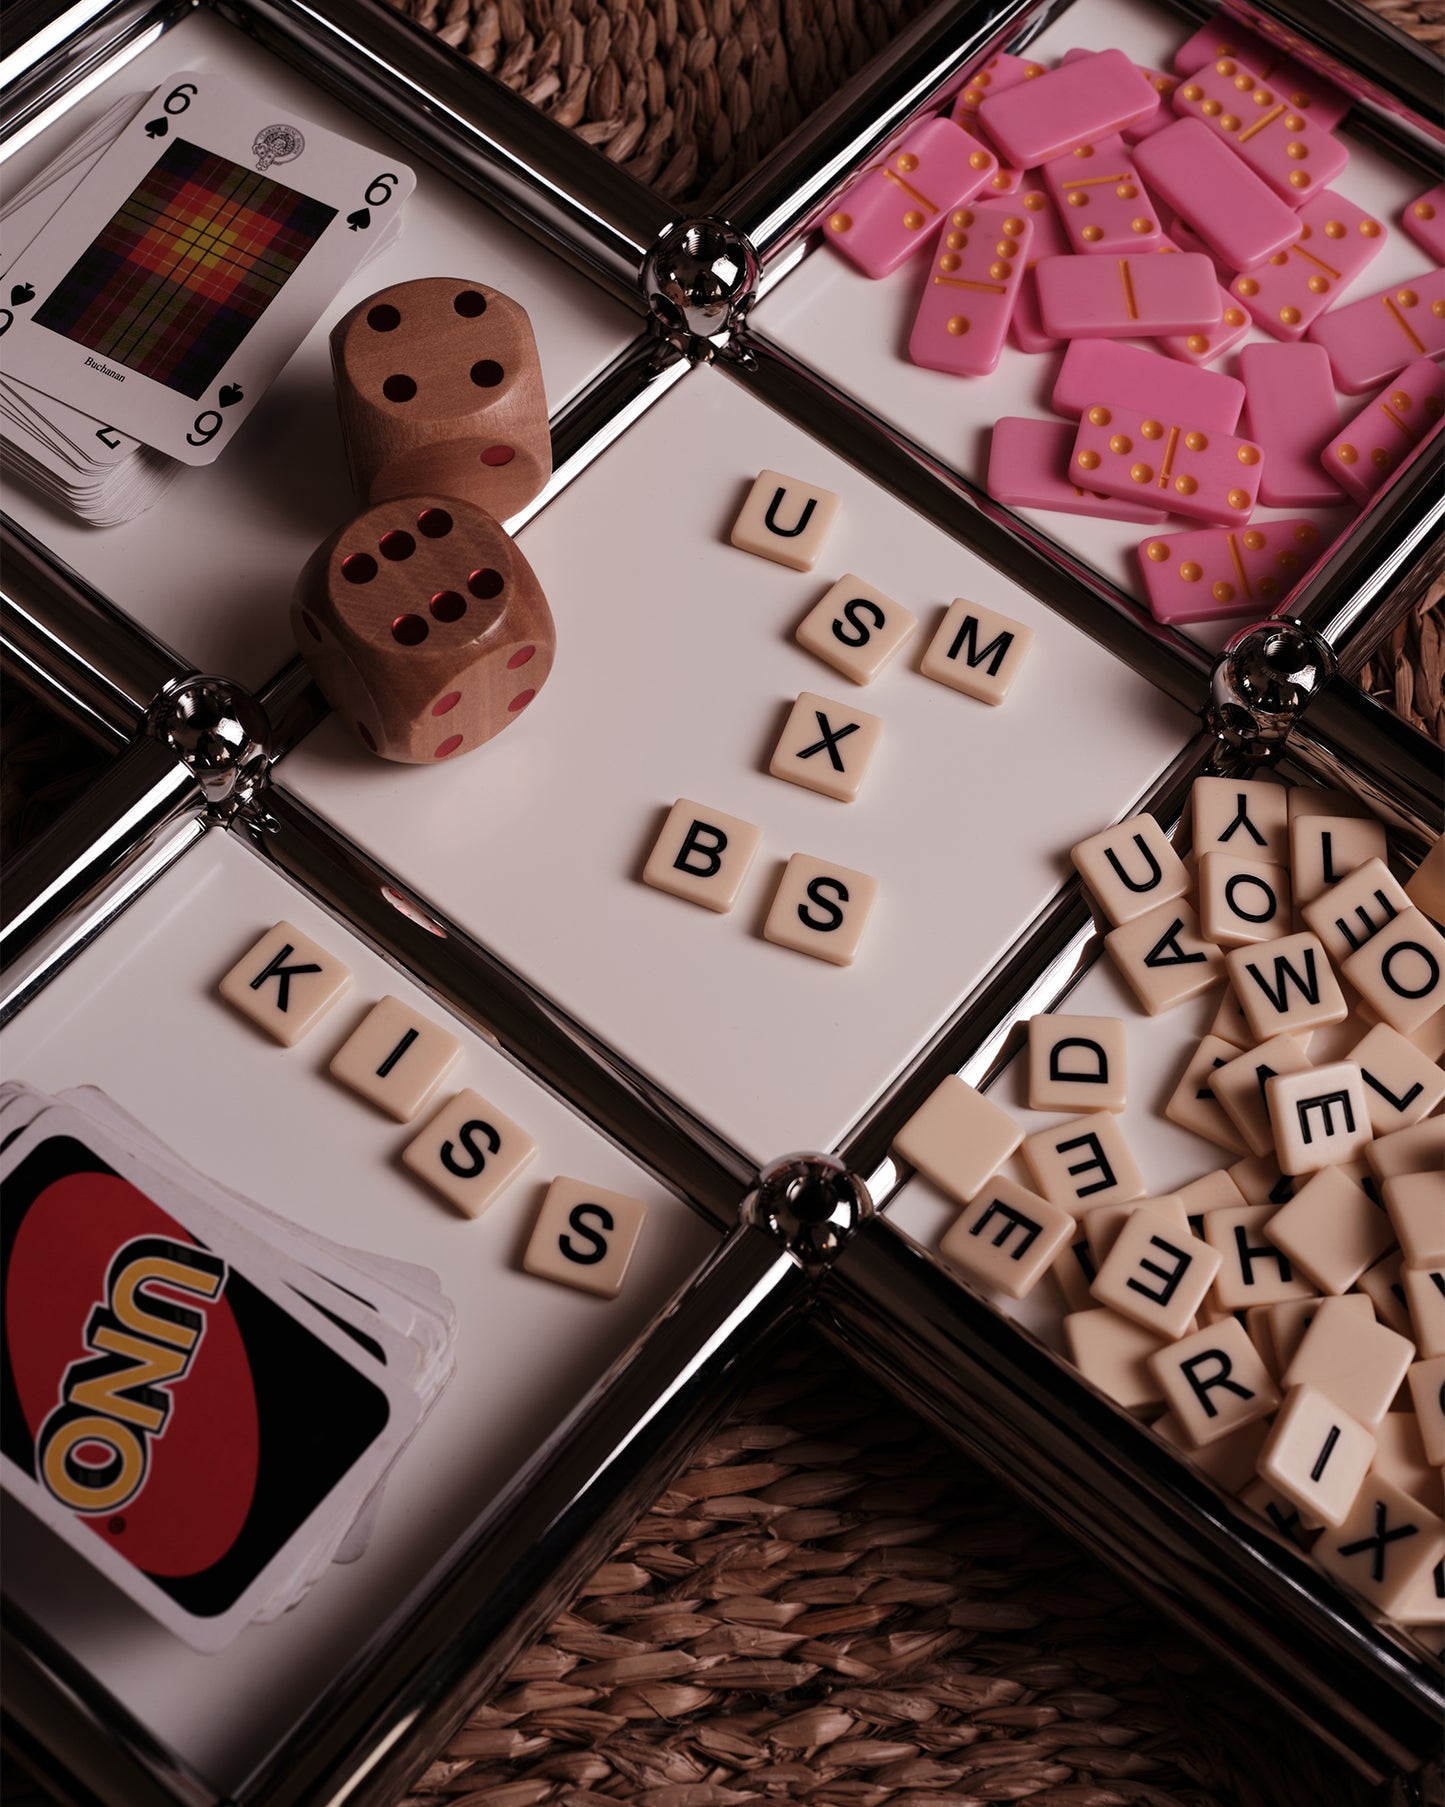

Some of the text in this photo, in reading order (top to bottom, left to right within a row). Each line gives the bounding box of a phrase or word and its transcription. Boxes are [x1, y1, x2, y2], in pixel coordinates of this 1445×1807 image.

[164, 84, 198, 115] 6
[364, 173, 399, 206] 6
[84, 356, 126, 383] Buchanan
[186, 410, 224, 447] 6
[764, 487, 817, 537] U
[796, 711, 860, 773] X
[1217, 793, 1269, 847] Y
[1103, 833, 1162, 893] U
[1224, 873, 1277, 924] O
[1143, 917, 1208, 968] A
[1381, 940, 1440, 999] O
[1245, 948, 1321, 1014] W
[1049, 1037, 1109, 1085] D
[1296, 1089, 1356, 1145] E
[1055, 1132, 1118, 1199] E
[968, 1198, 1044, 1262] E
[1126, 1235, 1193, 1307] E
[34, 1234, 230, 1517] UNO
[1179, 1348, 1257, 1419] R
[1310, 1425, 1341, 1482] I
[1336, 1500, 1420, 1584] X
